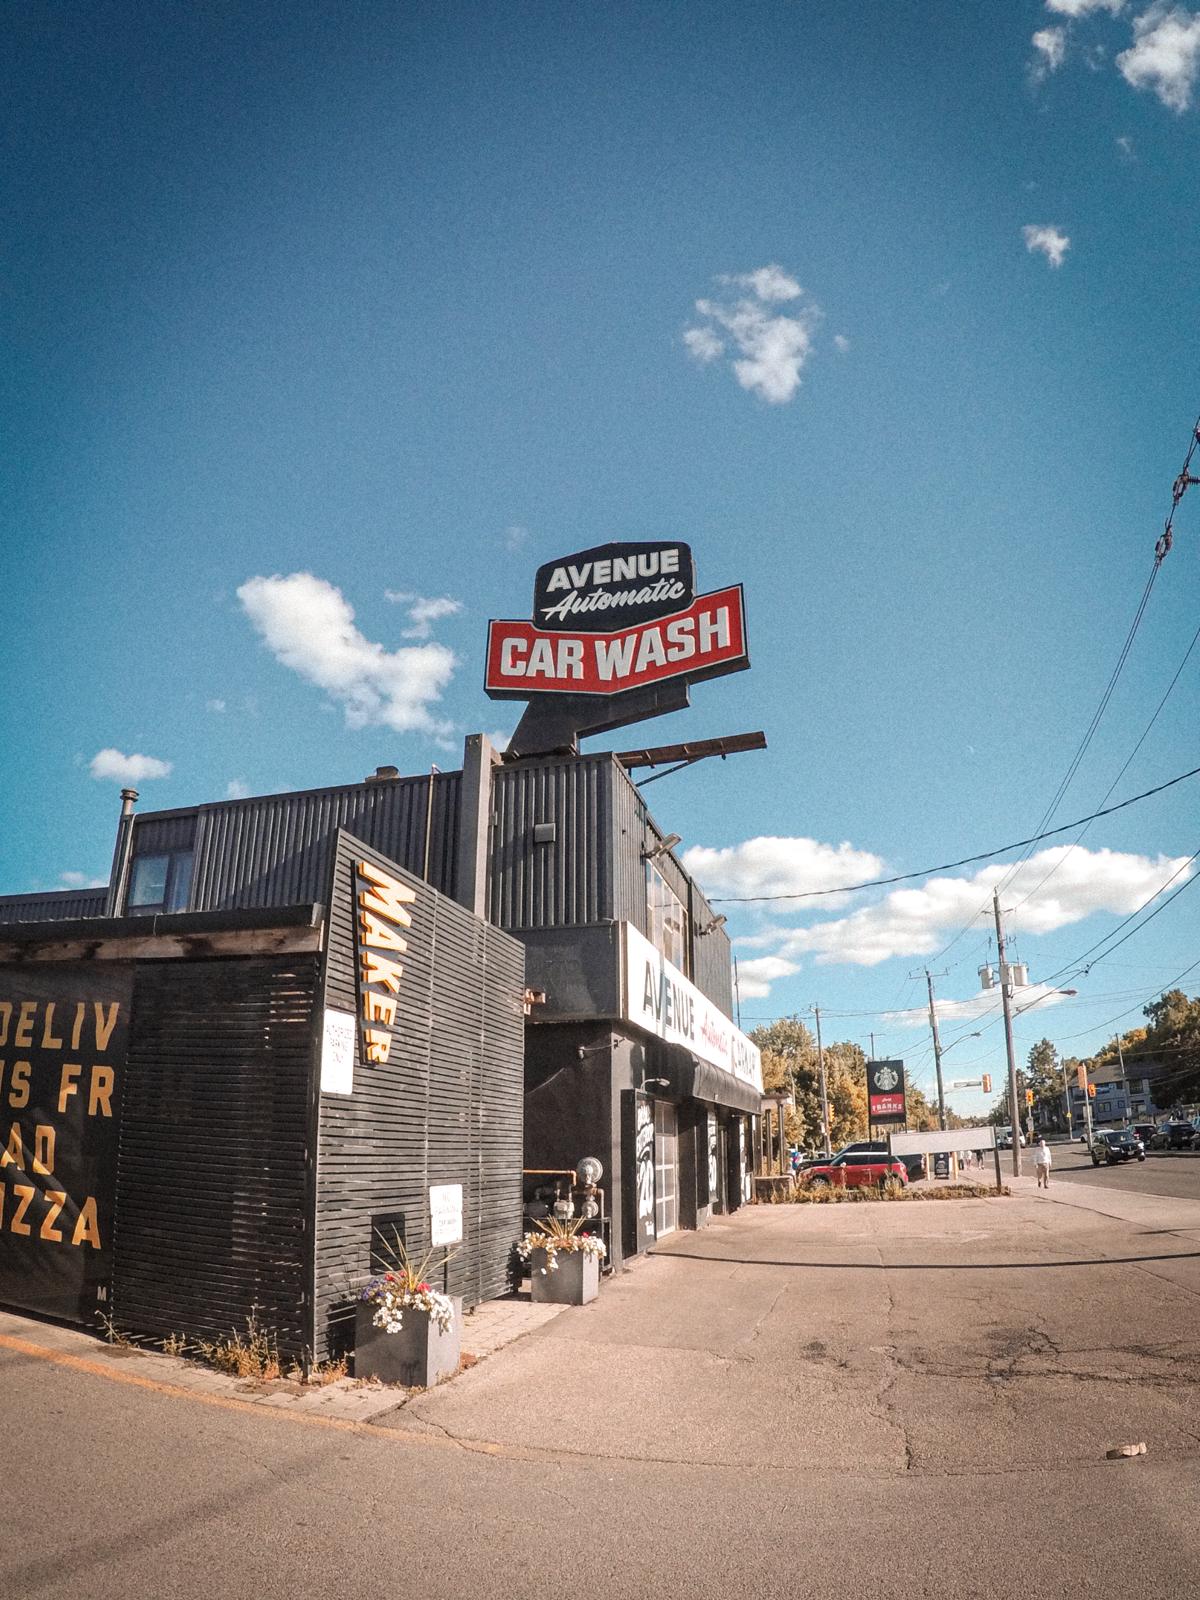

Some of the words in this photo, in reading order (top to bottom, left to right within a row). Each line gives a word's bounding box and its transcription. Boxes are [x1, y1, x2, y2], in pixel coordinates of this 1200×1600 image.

[541, 578, 686, 622] Automatic
[546, 549, 680, 593] AVENUE
[500, 637, 585, 680] CAR
[594, 606, 731, 681] WASH
[359, 861, 416, 1063] MAKER
[643, 960, 695, 1041] AVENUE
[58, 1064, 115, 1117] FR
